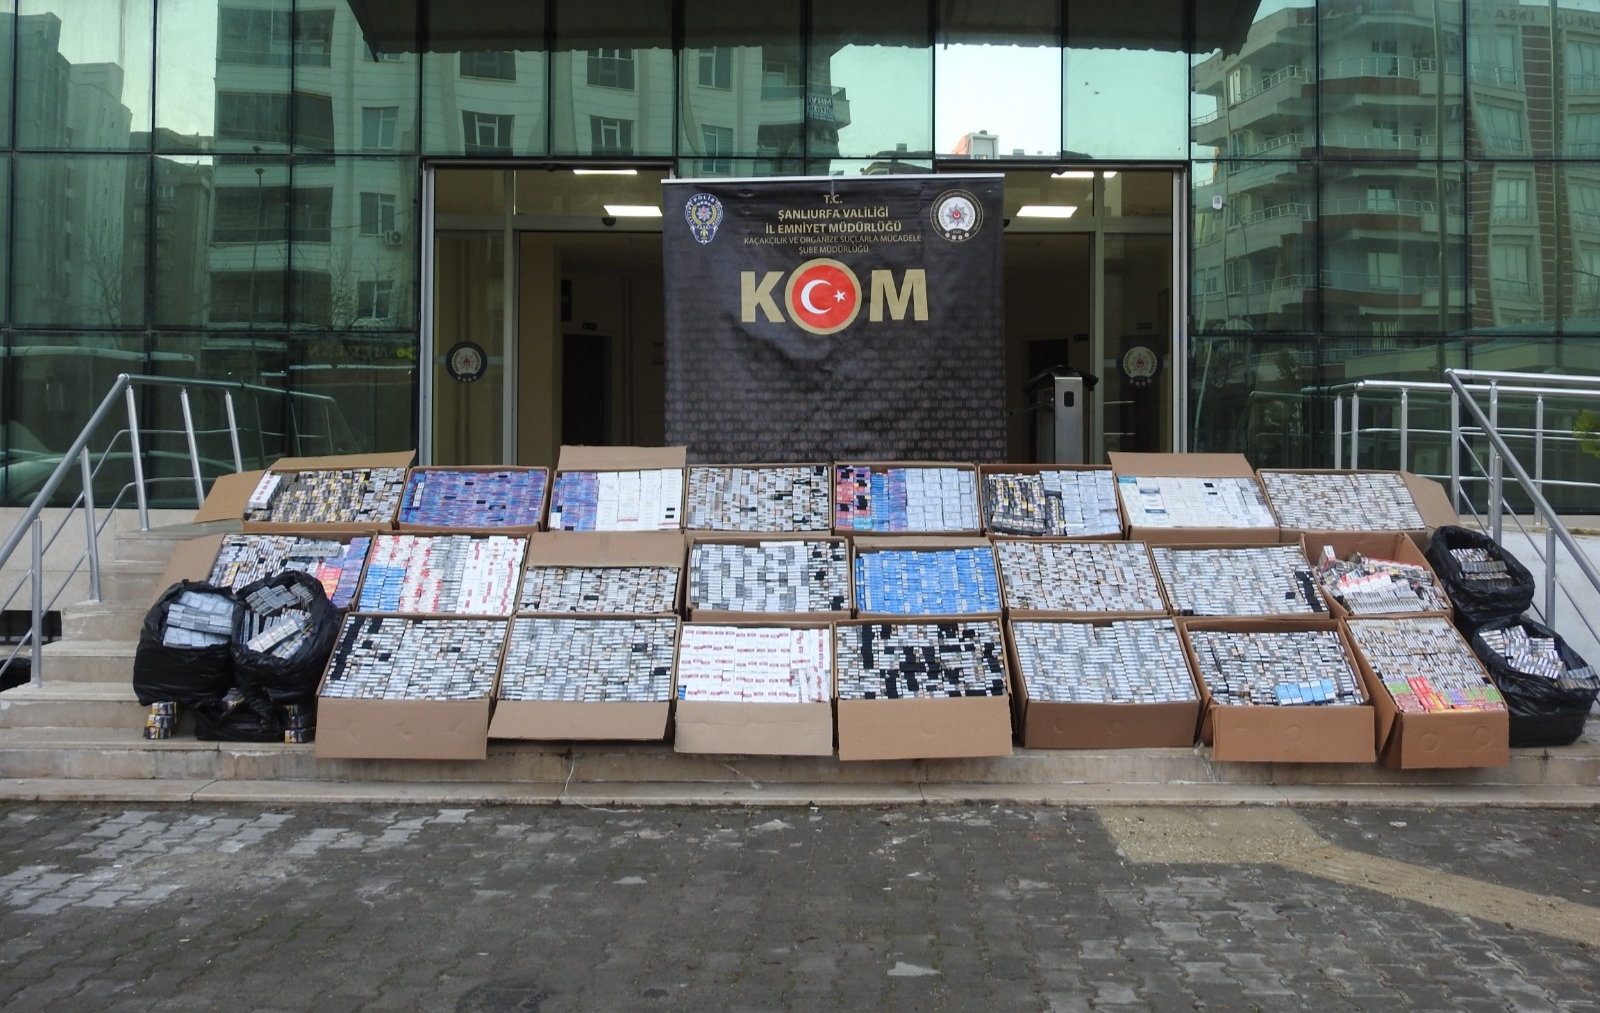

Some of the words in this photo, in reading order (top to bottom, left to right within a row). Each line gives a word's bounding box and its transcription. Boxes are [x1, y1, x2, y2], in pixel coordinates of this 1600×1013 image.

[824, 195, 843, 204] T.C.
[778, 209, 840, 221] ŞANLIURFA
[842, 207, 888, 217] VALİLİĞİ
[766, 223, 775, 234] İL
[778, 221, 826, 233] EMNİYET
[829, 221, 901, 232] MÜDÜRLÜĞÜ
[744, 235, 787, 245] KAÇAKÇILIK
[788, 236, 798, 244] VE
[800, 235, 837, 244] ORGANİZE
[839, 235, 878, 245] SUÇLARLA
[880, 234, 922, 243] MÜCADELE
[799, 246, 818, 255] ŞUBE
[819, 245, 869, 254] MÜDÜRLÜĞÜ
